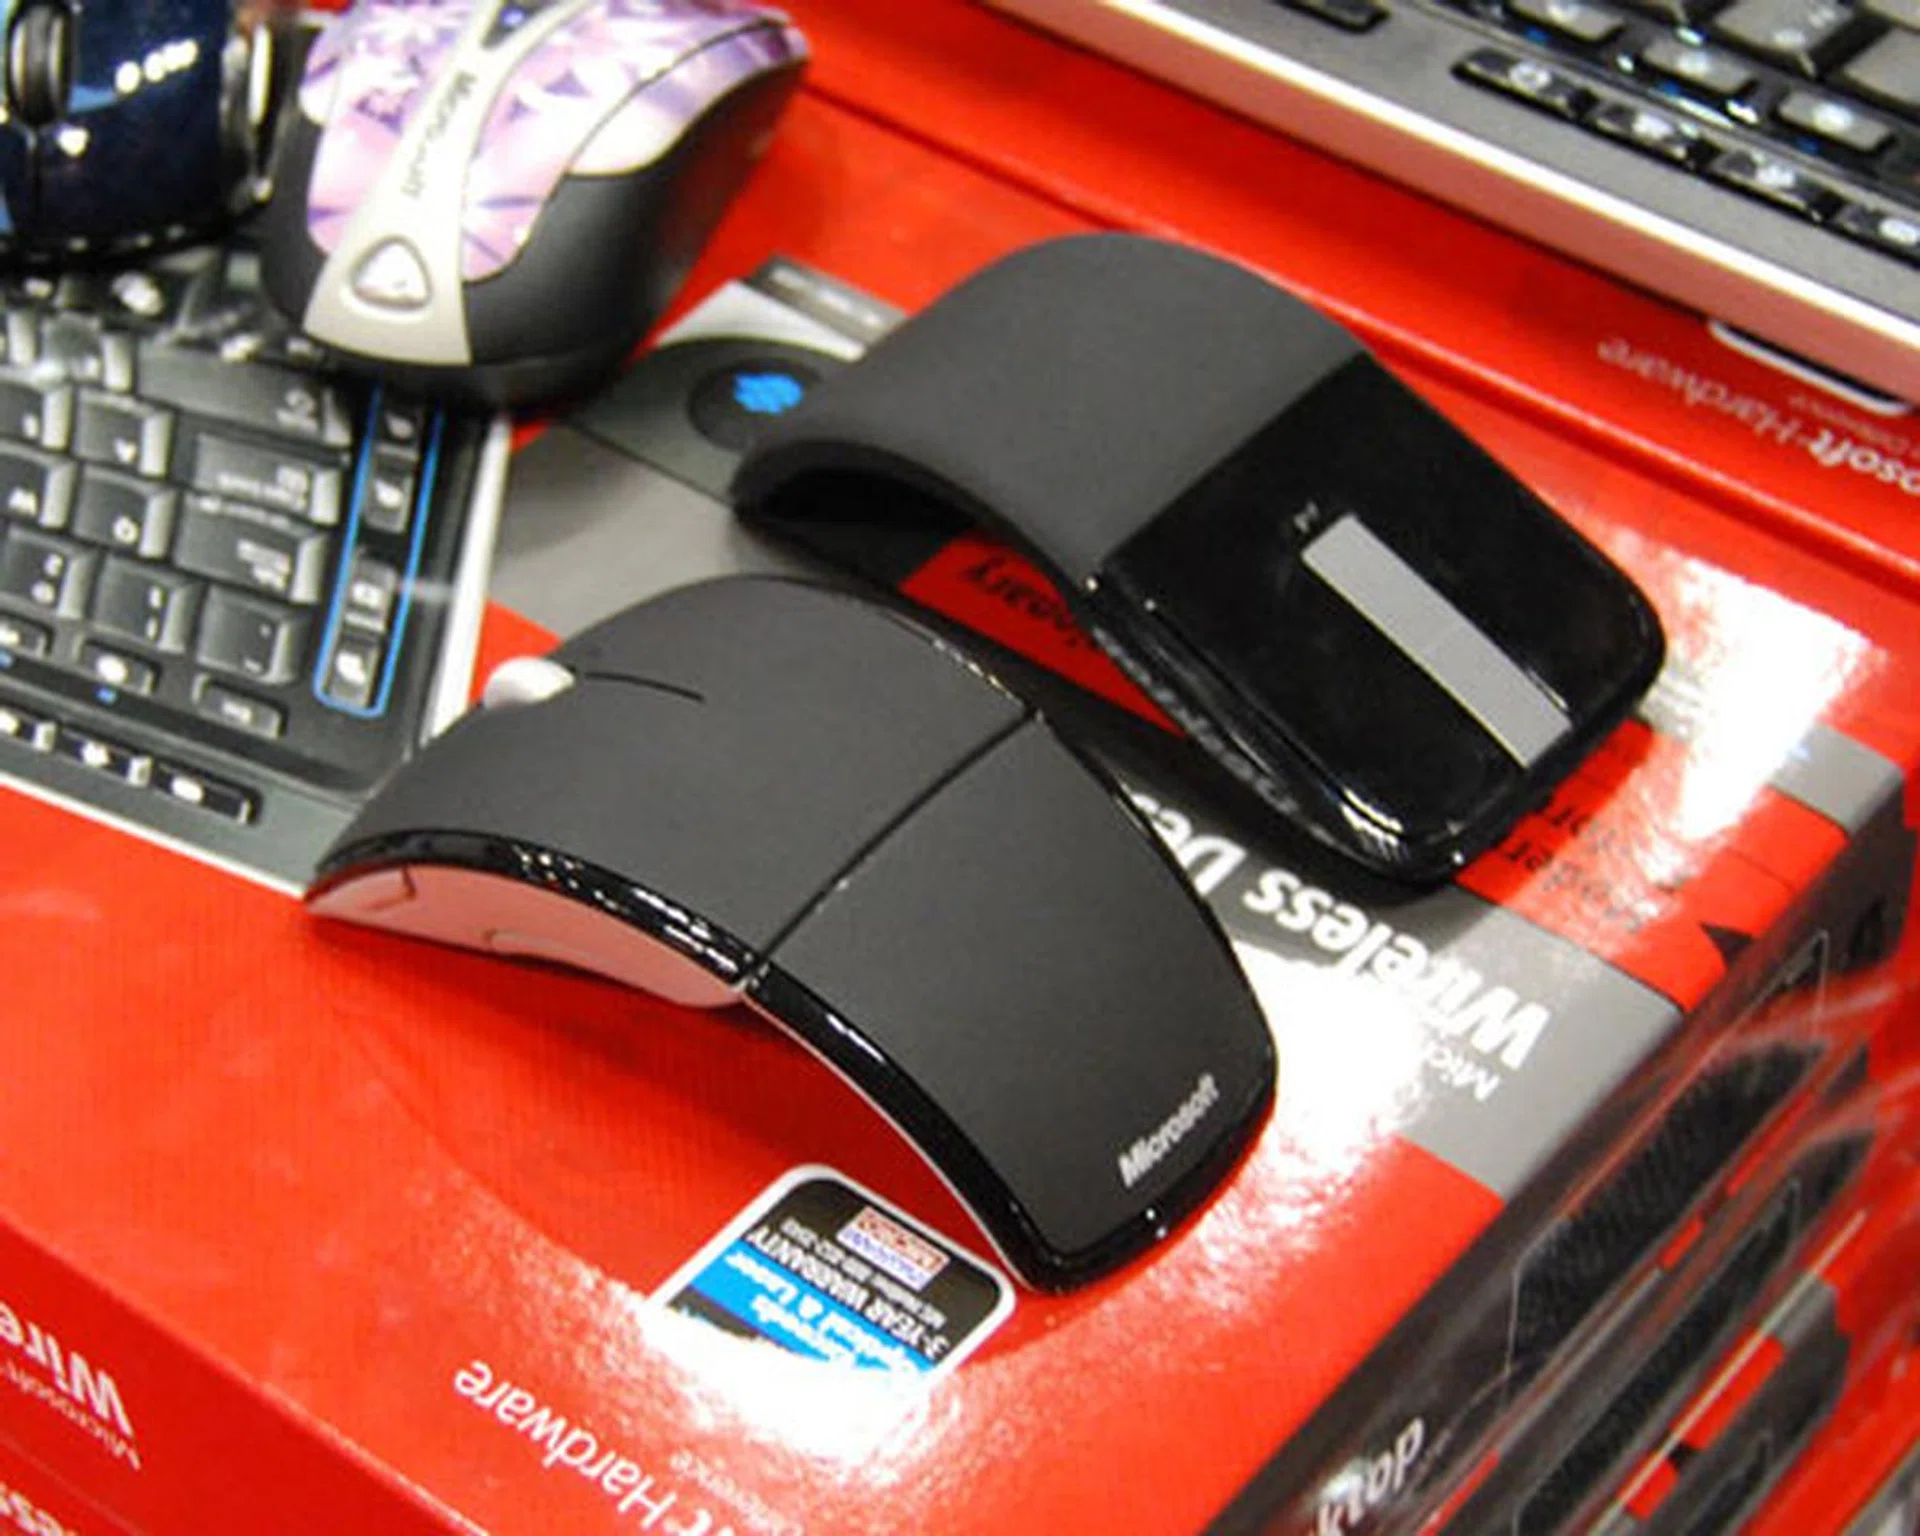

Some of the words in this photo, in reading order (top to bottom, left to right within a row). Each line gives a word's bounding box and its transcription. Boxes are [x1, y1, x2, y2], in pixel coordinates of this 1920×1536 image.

[1242, 866, 1551, 1070] Wireless
[1118, 1072, 1220, 1188] Microsoft
[453, 1359, 678, 1531] Hardware
